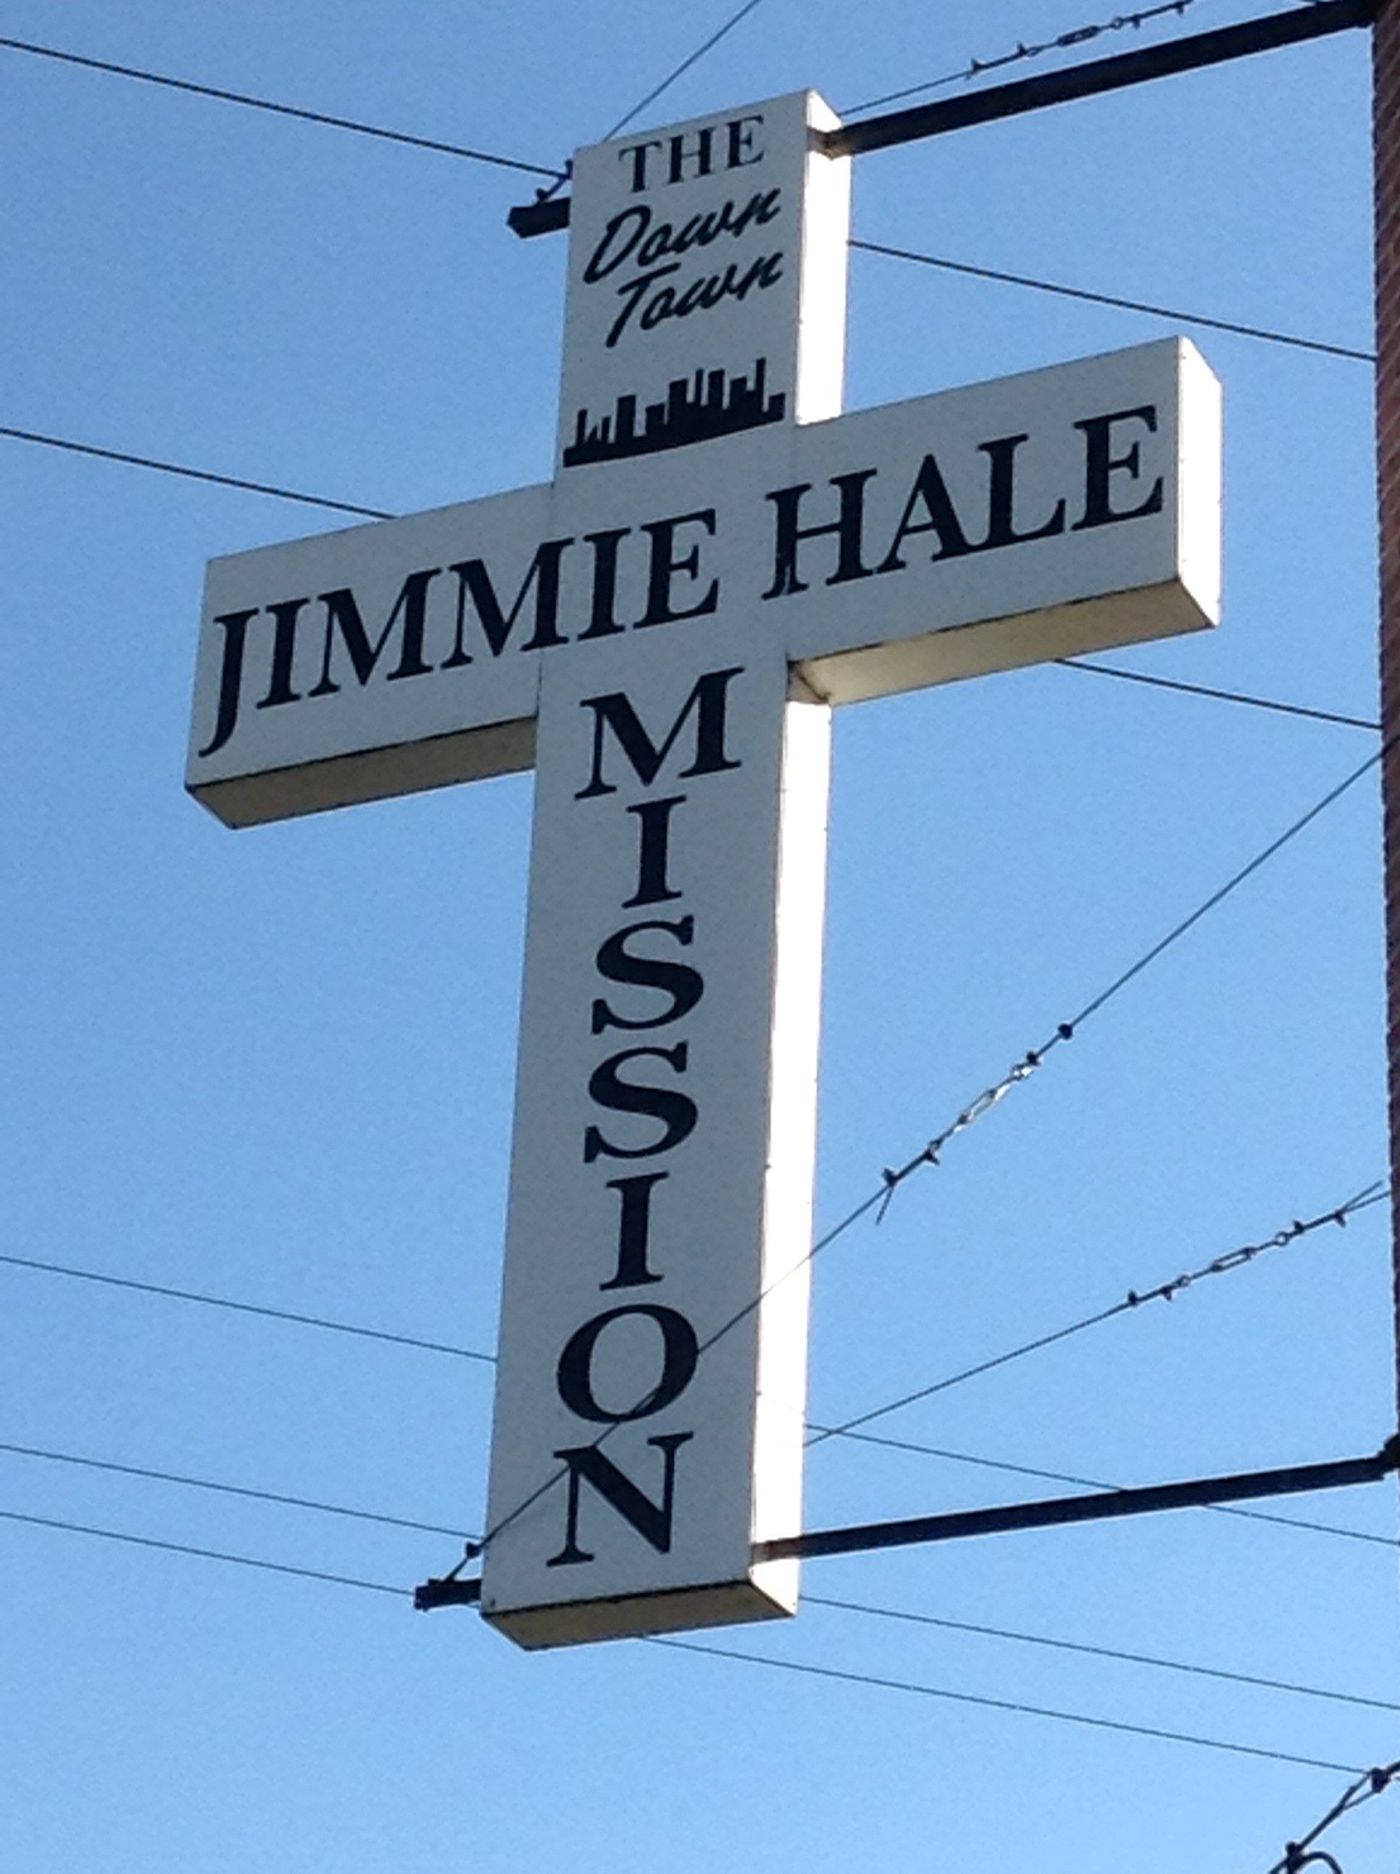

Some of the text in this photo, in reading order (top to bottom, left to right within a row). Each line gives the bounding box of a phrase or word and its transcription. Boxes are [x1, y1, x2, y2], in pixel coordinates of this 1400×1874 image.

[618, 114, 766, 194] THE
[583, 188, 782, 285] Down
[605, 252, 784, 349] Town
[197, 404, 1165, 759] JIMMIE HALE
[546, 665, 746, 1568] MISSION
